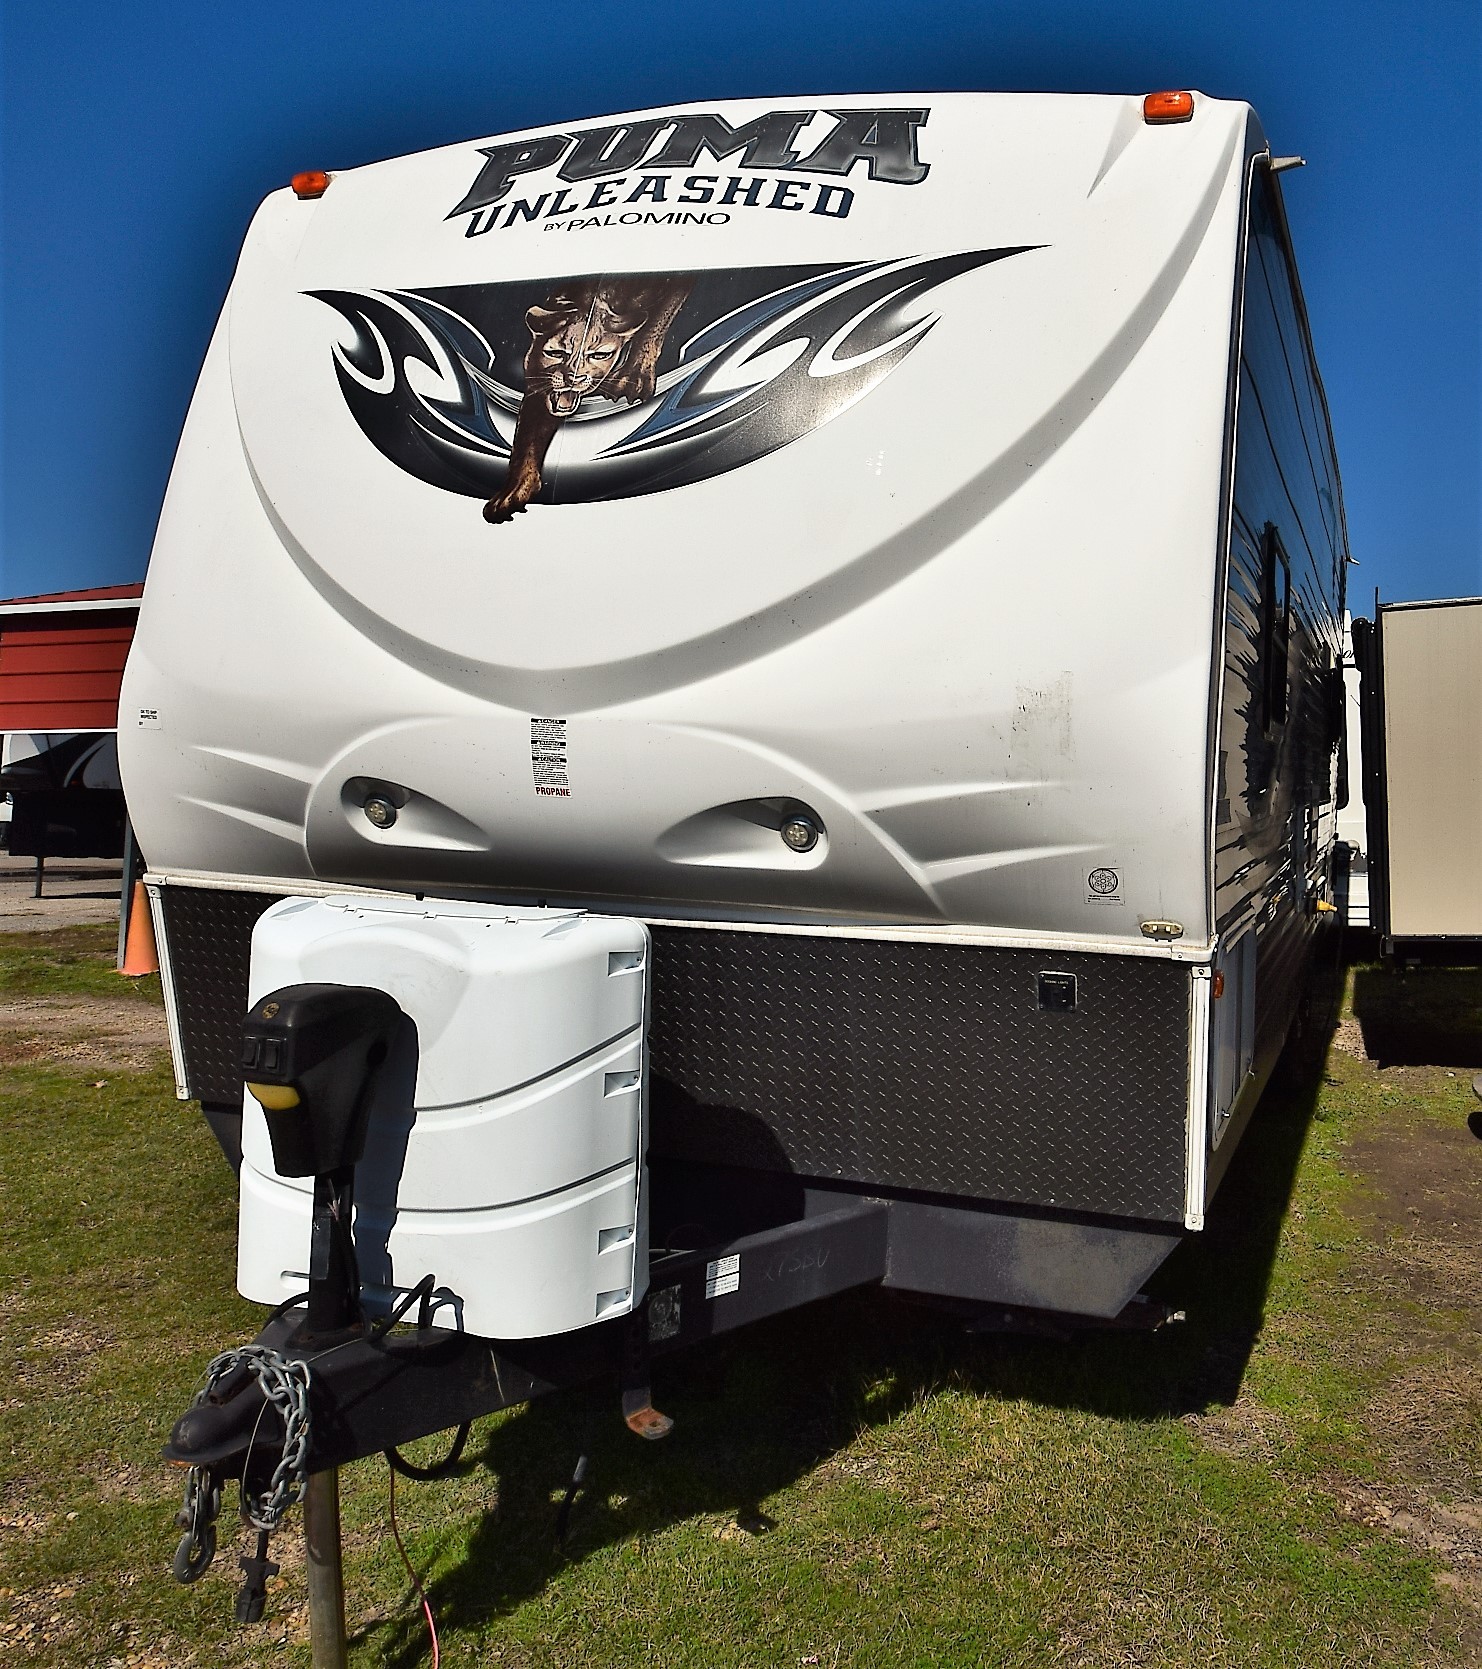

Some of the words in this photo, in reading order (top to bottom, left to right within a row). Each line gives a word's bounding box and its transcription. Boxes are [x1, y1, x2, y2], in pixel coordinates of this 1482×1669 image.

[444, 108, 931, 221] PUMA
[465, 175, 855, 238] UNLEASHED
[543, 221, 567, 232] BY
[566, 212, 731, 232] PALOMINO
[535, 786, 572, 797] PROPANE
